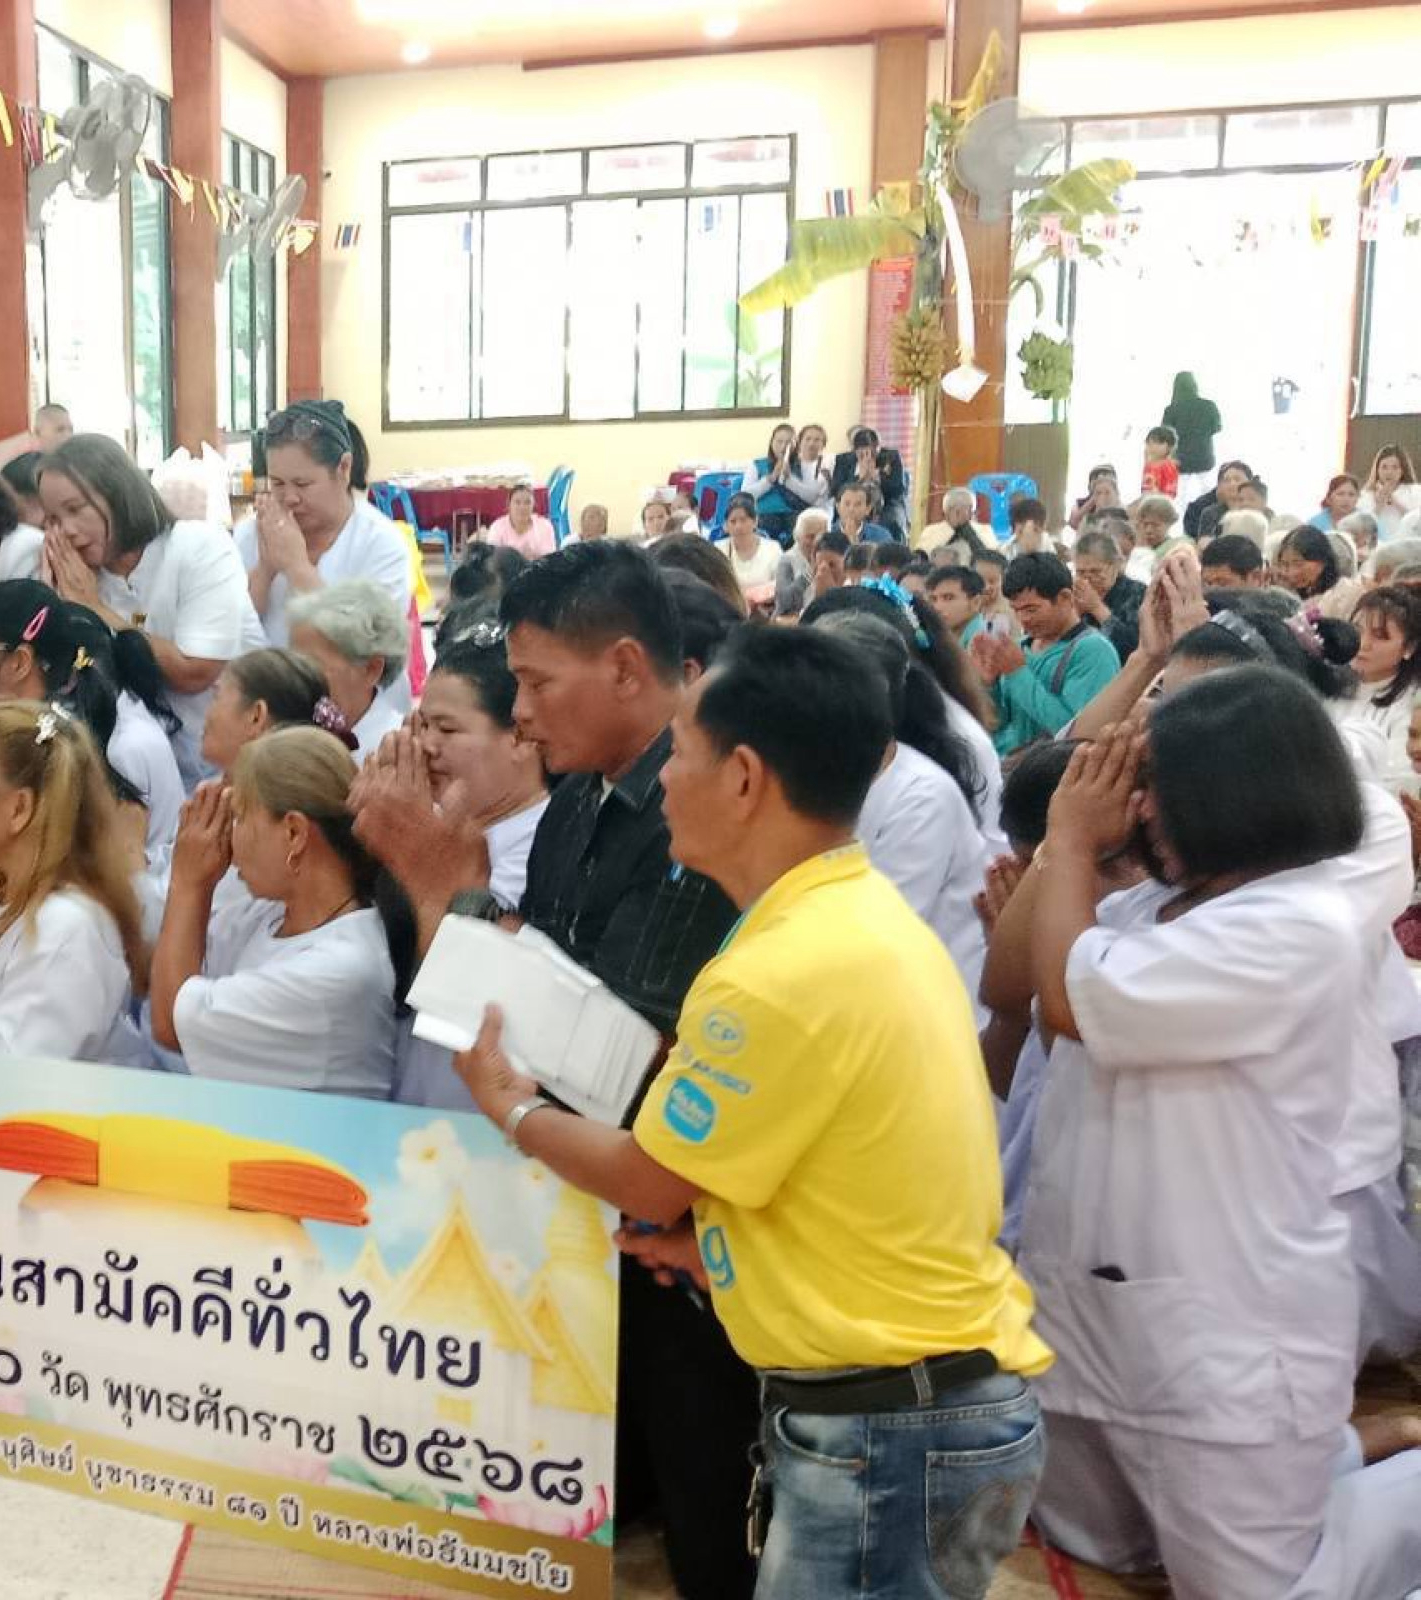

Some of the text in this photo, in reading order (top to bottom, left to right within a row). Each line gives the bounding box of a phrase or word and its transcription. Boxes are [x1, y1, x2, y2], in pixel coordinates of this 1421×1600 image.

[41, 1350, 89, 1402] วัด
[103, 1377, 336, 1454] พุทธศักราช
[358, 1414, 585, 1506] ๒๕๖๘
[85, 1458, 214, 1506] บูชาธรรม
[280, 1496, 300, 1527] ปี
[312, 1512, 570, 1589] หลวงพ่อธัมมชโย
